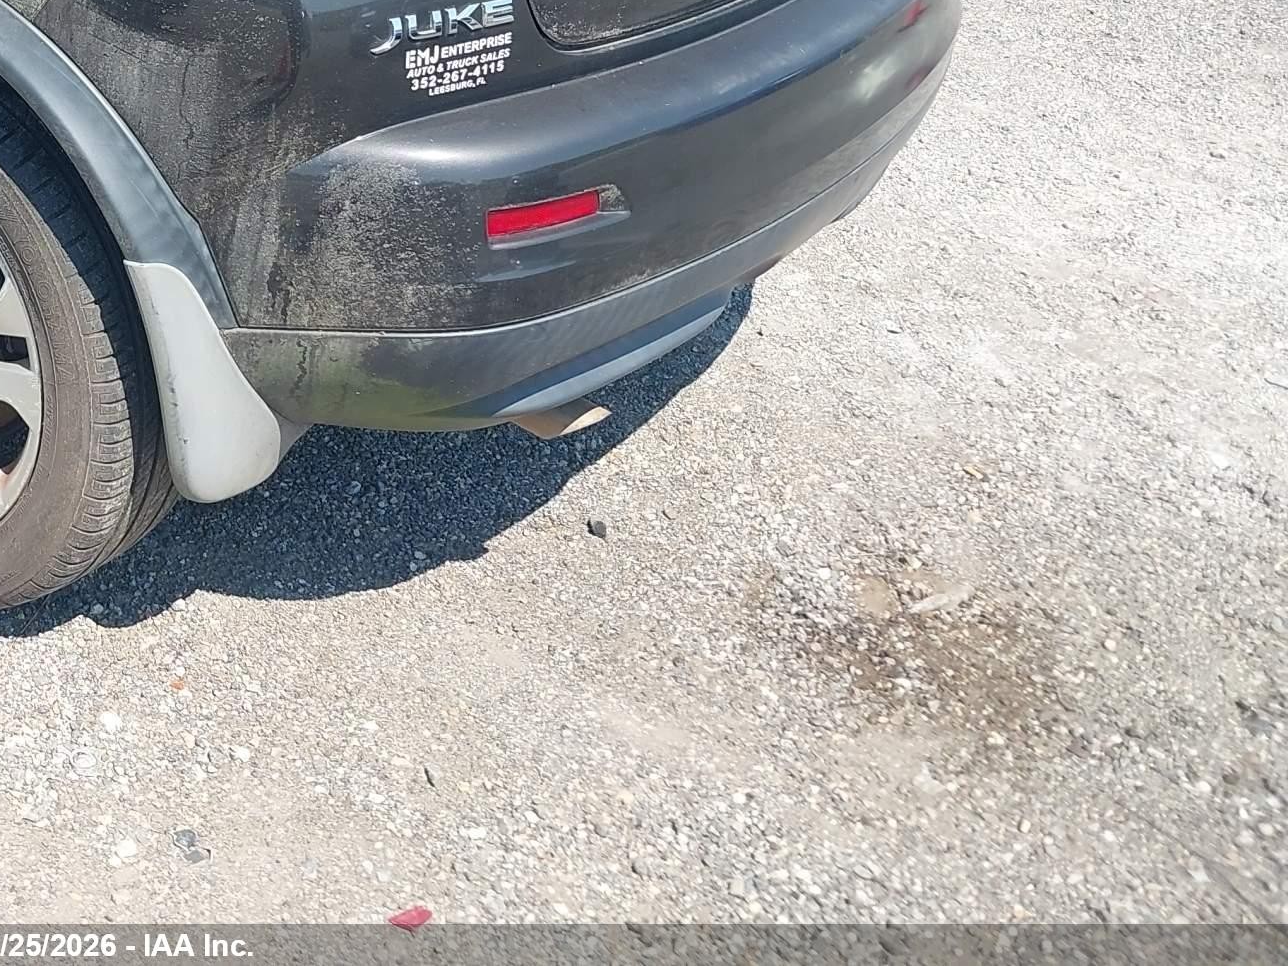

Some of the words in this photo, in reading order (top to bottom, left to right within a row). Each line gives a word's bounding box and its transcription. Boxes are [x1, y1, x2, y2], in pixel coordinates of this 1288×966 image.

[406, 45, 439, 69] EMJ
[441, 32, 512, 58] ENTERPRISE
[407, 65, 435, 78] AUTO
[437, 63, 444, 73] &
[446, 55, 479, 70] TRUCK
[480, 48, 510, 63] SALES
[411, 60, 504, 91] 352-267-4115
